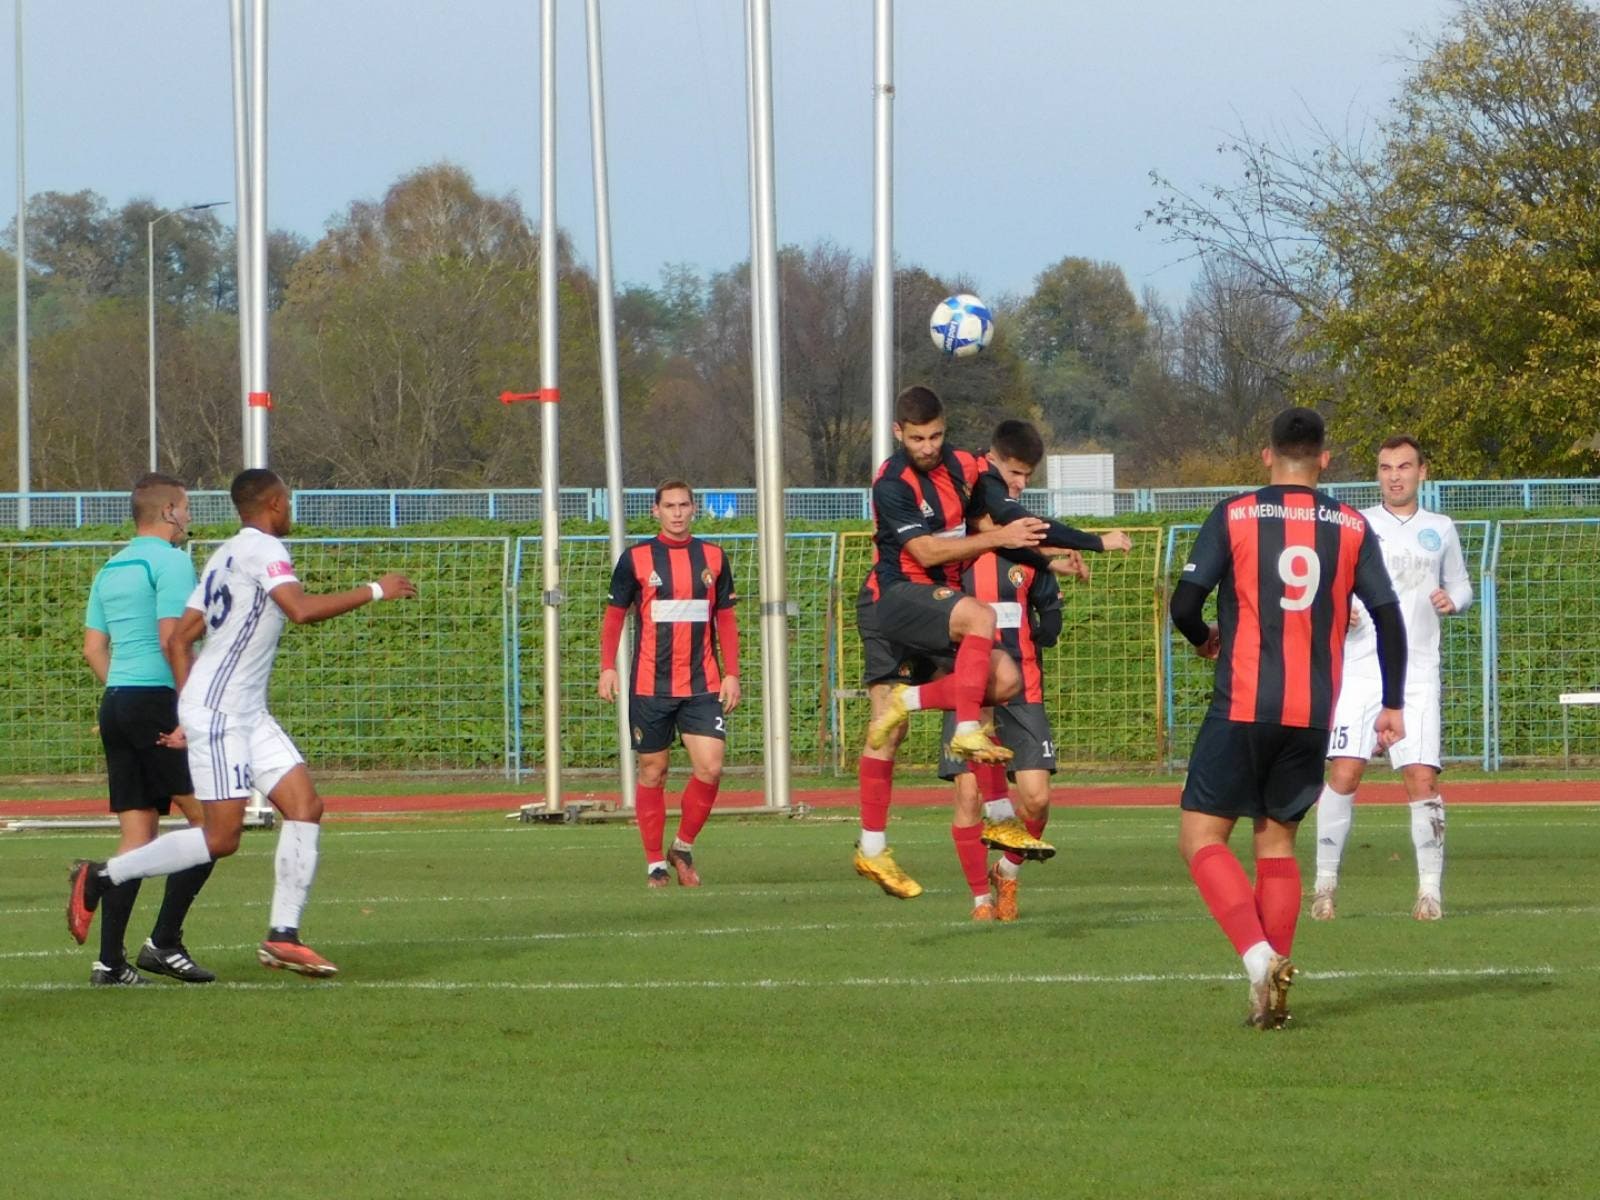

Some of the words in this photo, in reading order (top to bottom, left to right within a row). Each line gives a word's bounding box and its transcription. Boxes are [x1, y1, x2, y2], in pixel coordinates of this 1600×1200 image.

[1230, 507, 1247, 521] NK
[1248, 503, 1316, 521] MEĐIMURJE
[1318, 505, 1365, 533] ČAKOVEC
[1278, 545, 1321, 612] 9
[1332, 726, 1350, 750] 15
